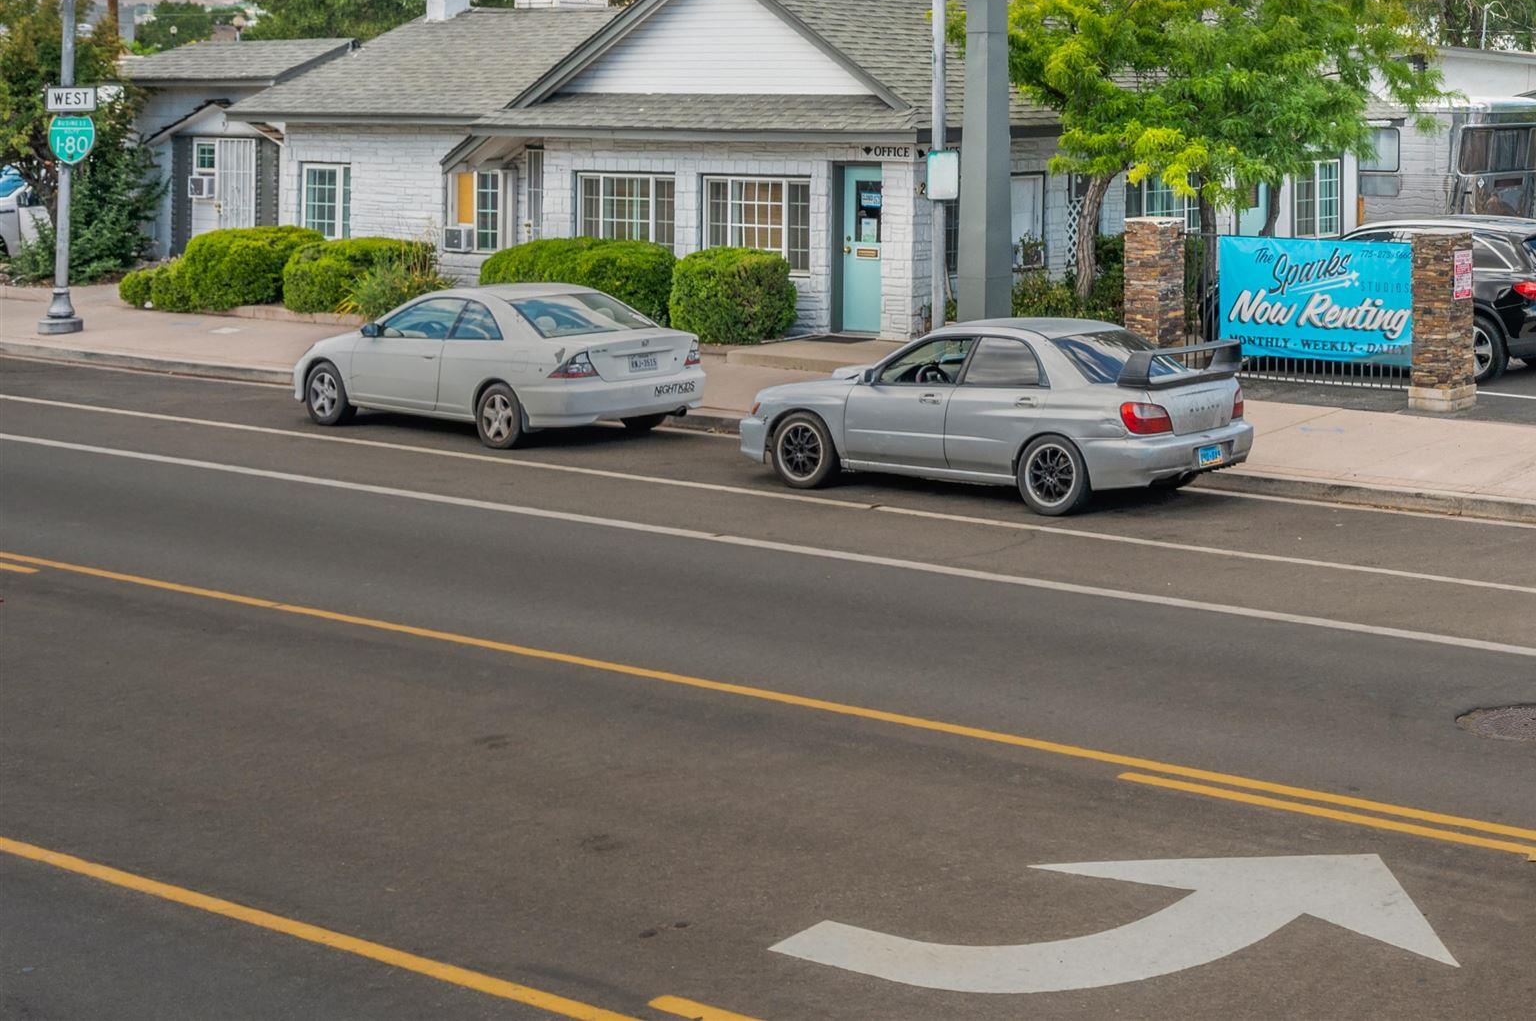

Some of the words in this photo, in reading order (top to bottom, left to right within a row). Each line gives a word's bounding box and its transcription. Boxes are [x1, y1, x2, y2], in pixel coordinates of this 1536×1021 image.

[54, 91, 89, 105] WEST
[56, 136, 89, 154] I-80
[874, 146, 910, 158] OFFICE
[1255, 247, 1274, 264] The
[1269, 247, 1351, 295] Sparks
[1360, 281, 1410, 294] STUDIOS
[1228, 289, 1297, 326] Now
[1297, 292, 1411, 341] Renting
[1301, 338, 1357, 353] WEEKLY
[1366, 343, 1409, 355] DAILY
